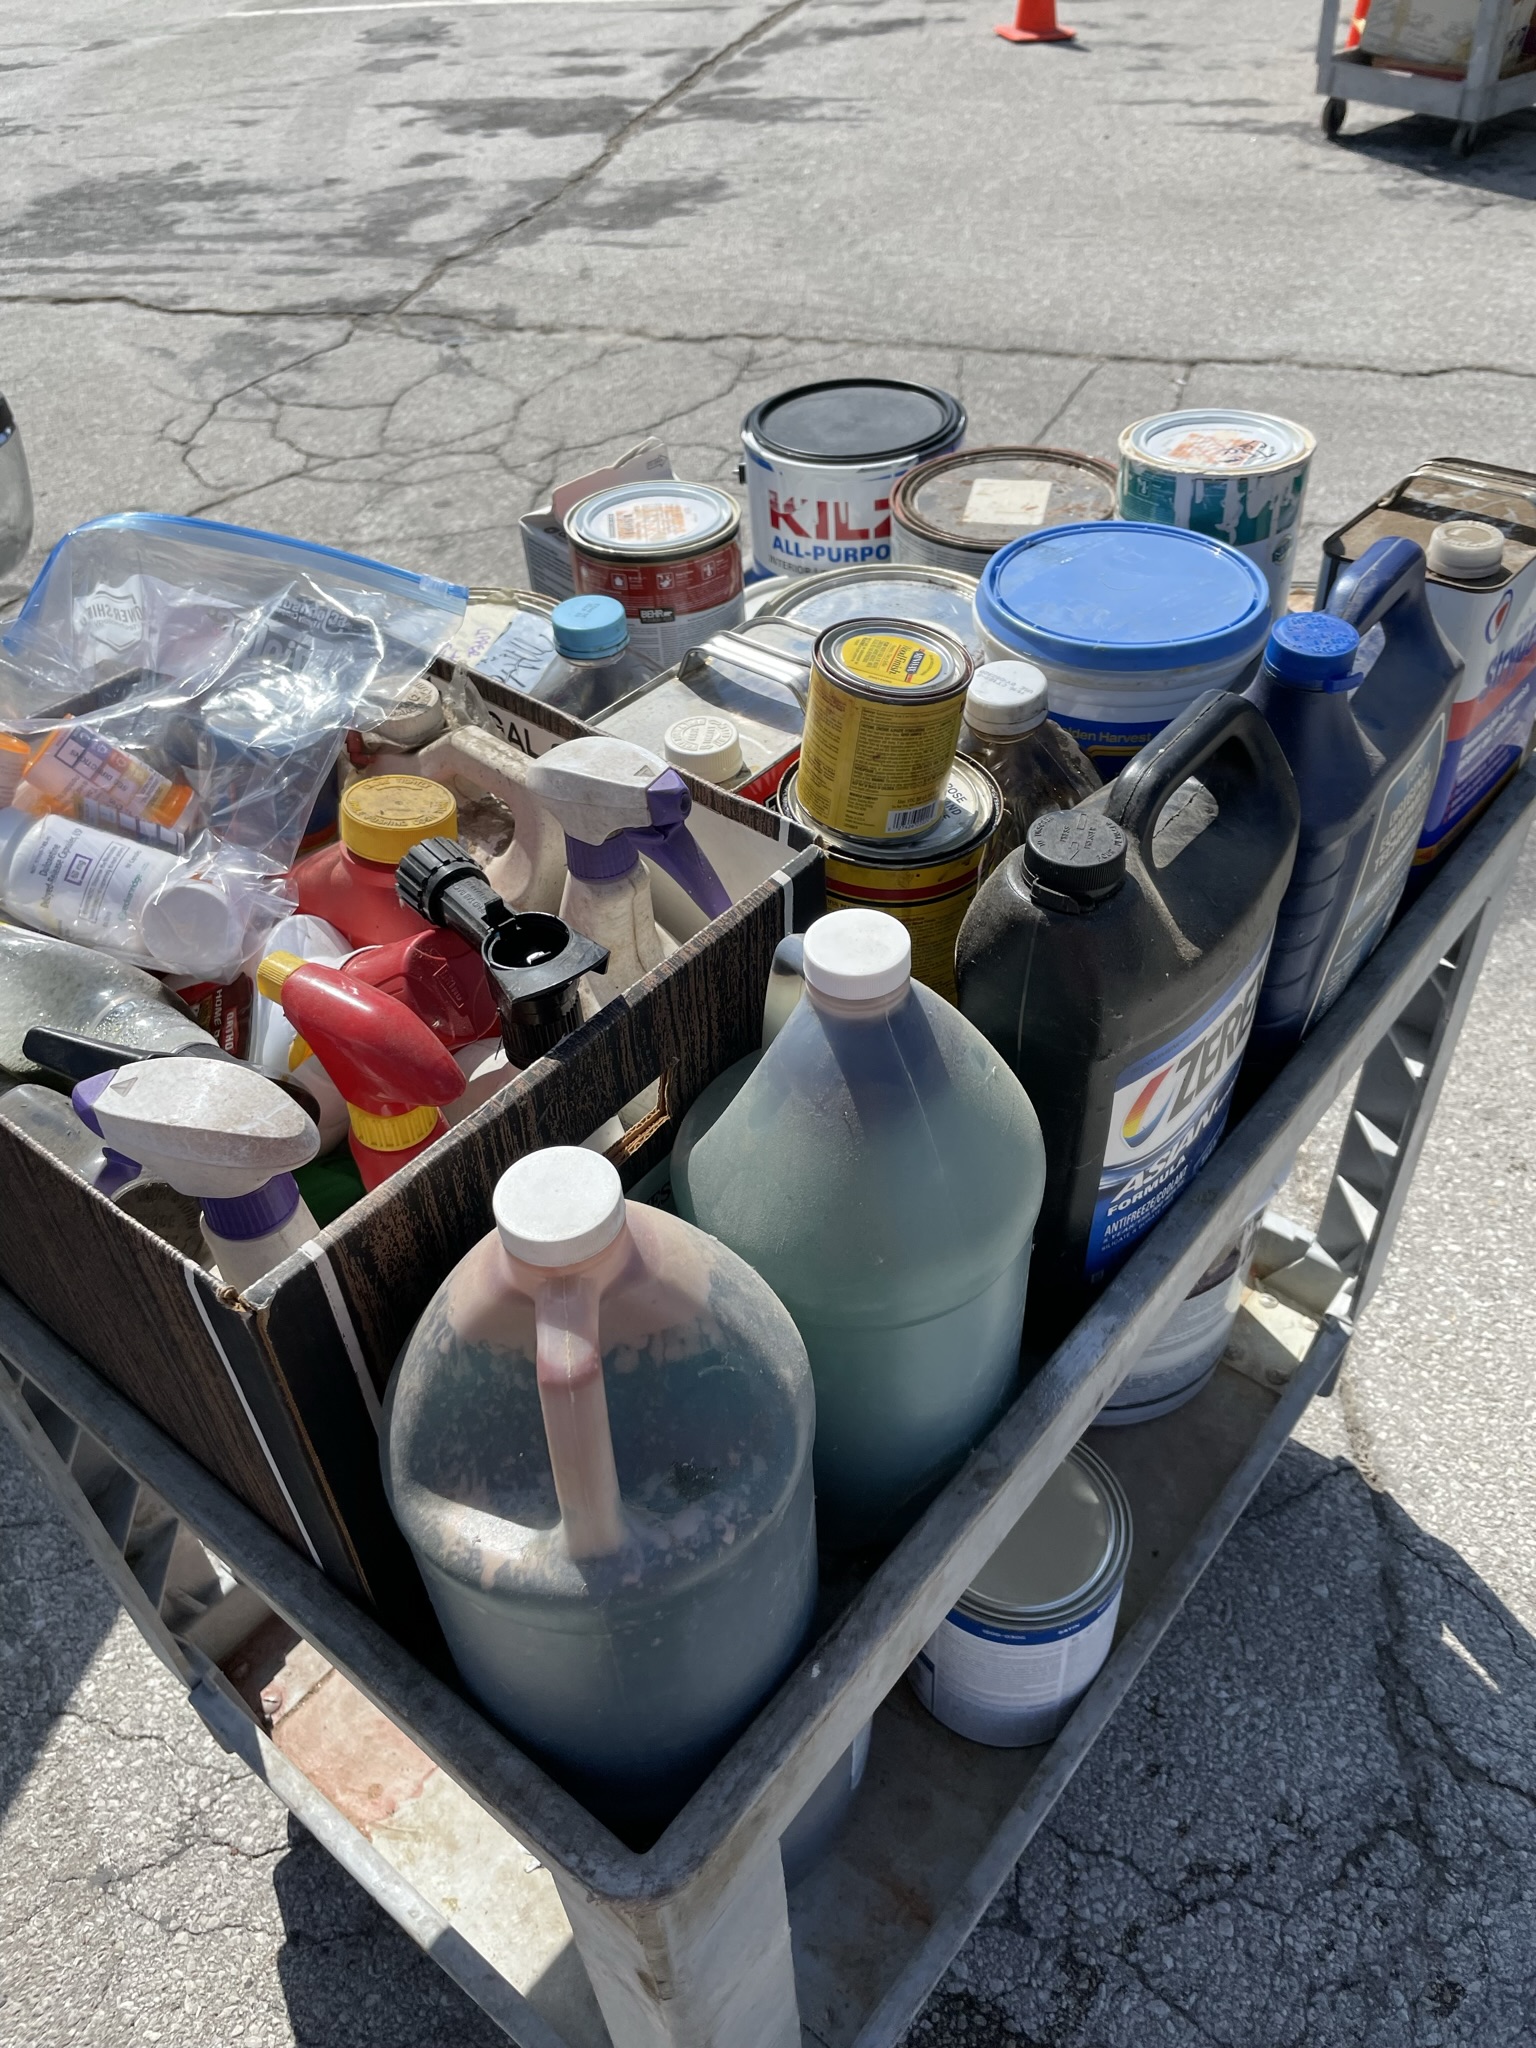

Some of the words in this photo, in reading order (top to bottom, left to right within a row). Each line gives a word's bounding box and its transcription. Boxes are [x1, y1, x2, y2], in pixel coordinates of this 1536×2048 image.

[640, 609, 664, 618] BEHR
[1063, 727, 1097, 741] lden
[214, 988, 223, 1027] HOME
[225, 1011, 235, 1051] ORTHO
[1111, 1098, 1219, 1203] ASIAN
[1107, 1154, 1187, 1218] FORMULA
